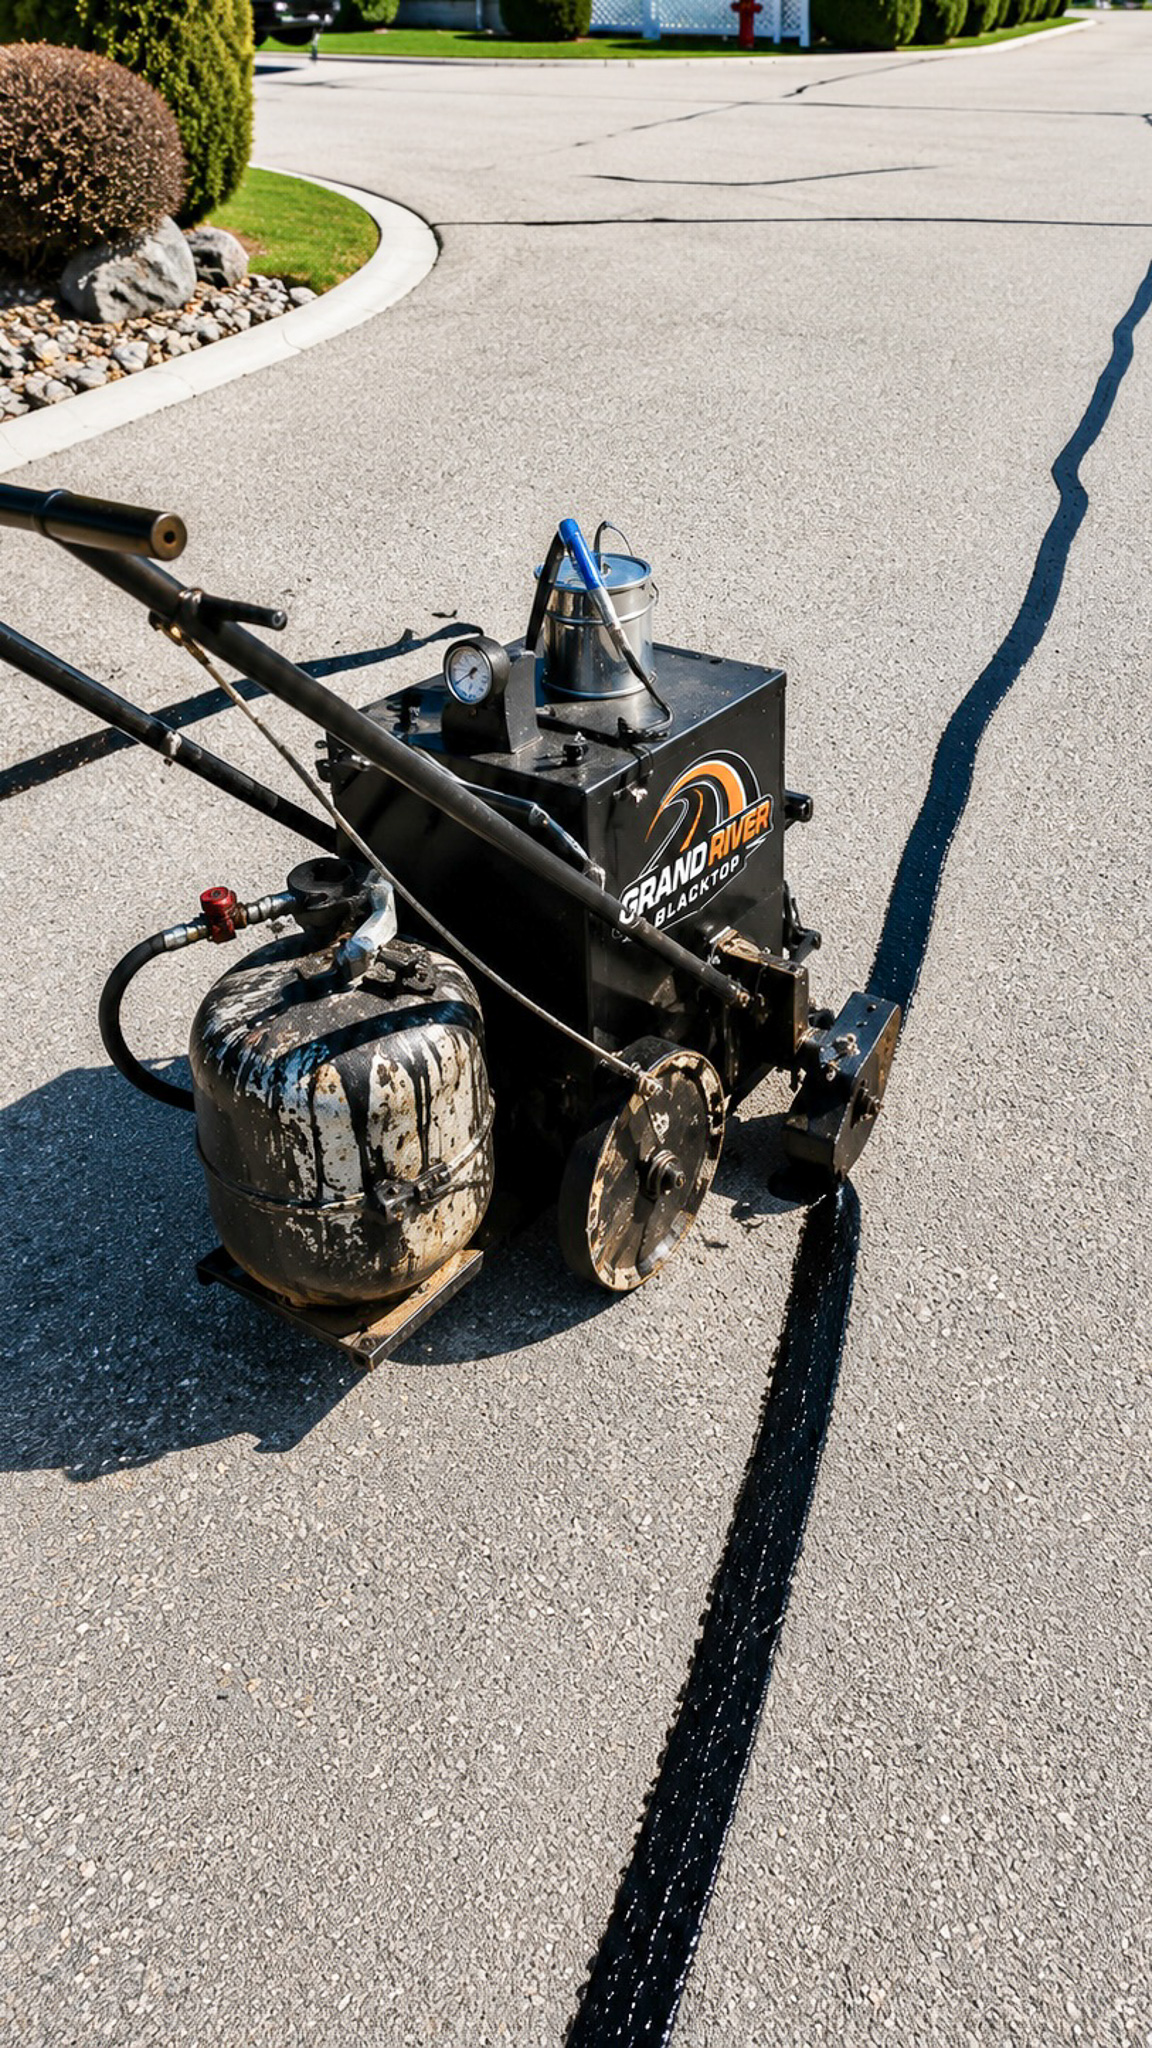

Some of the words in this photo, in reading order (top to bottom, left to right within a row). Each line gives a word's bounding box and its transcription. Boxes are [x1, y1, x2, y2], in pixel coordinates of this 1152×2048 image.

[619, 841, 708, 925] GRAND
[708, 799, 771, 866] RIVER
[654, 854, 740, 929] BLACKTOP
